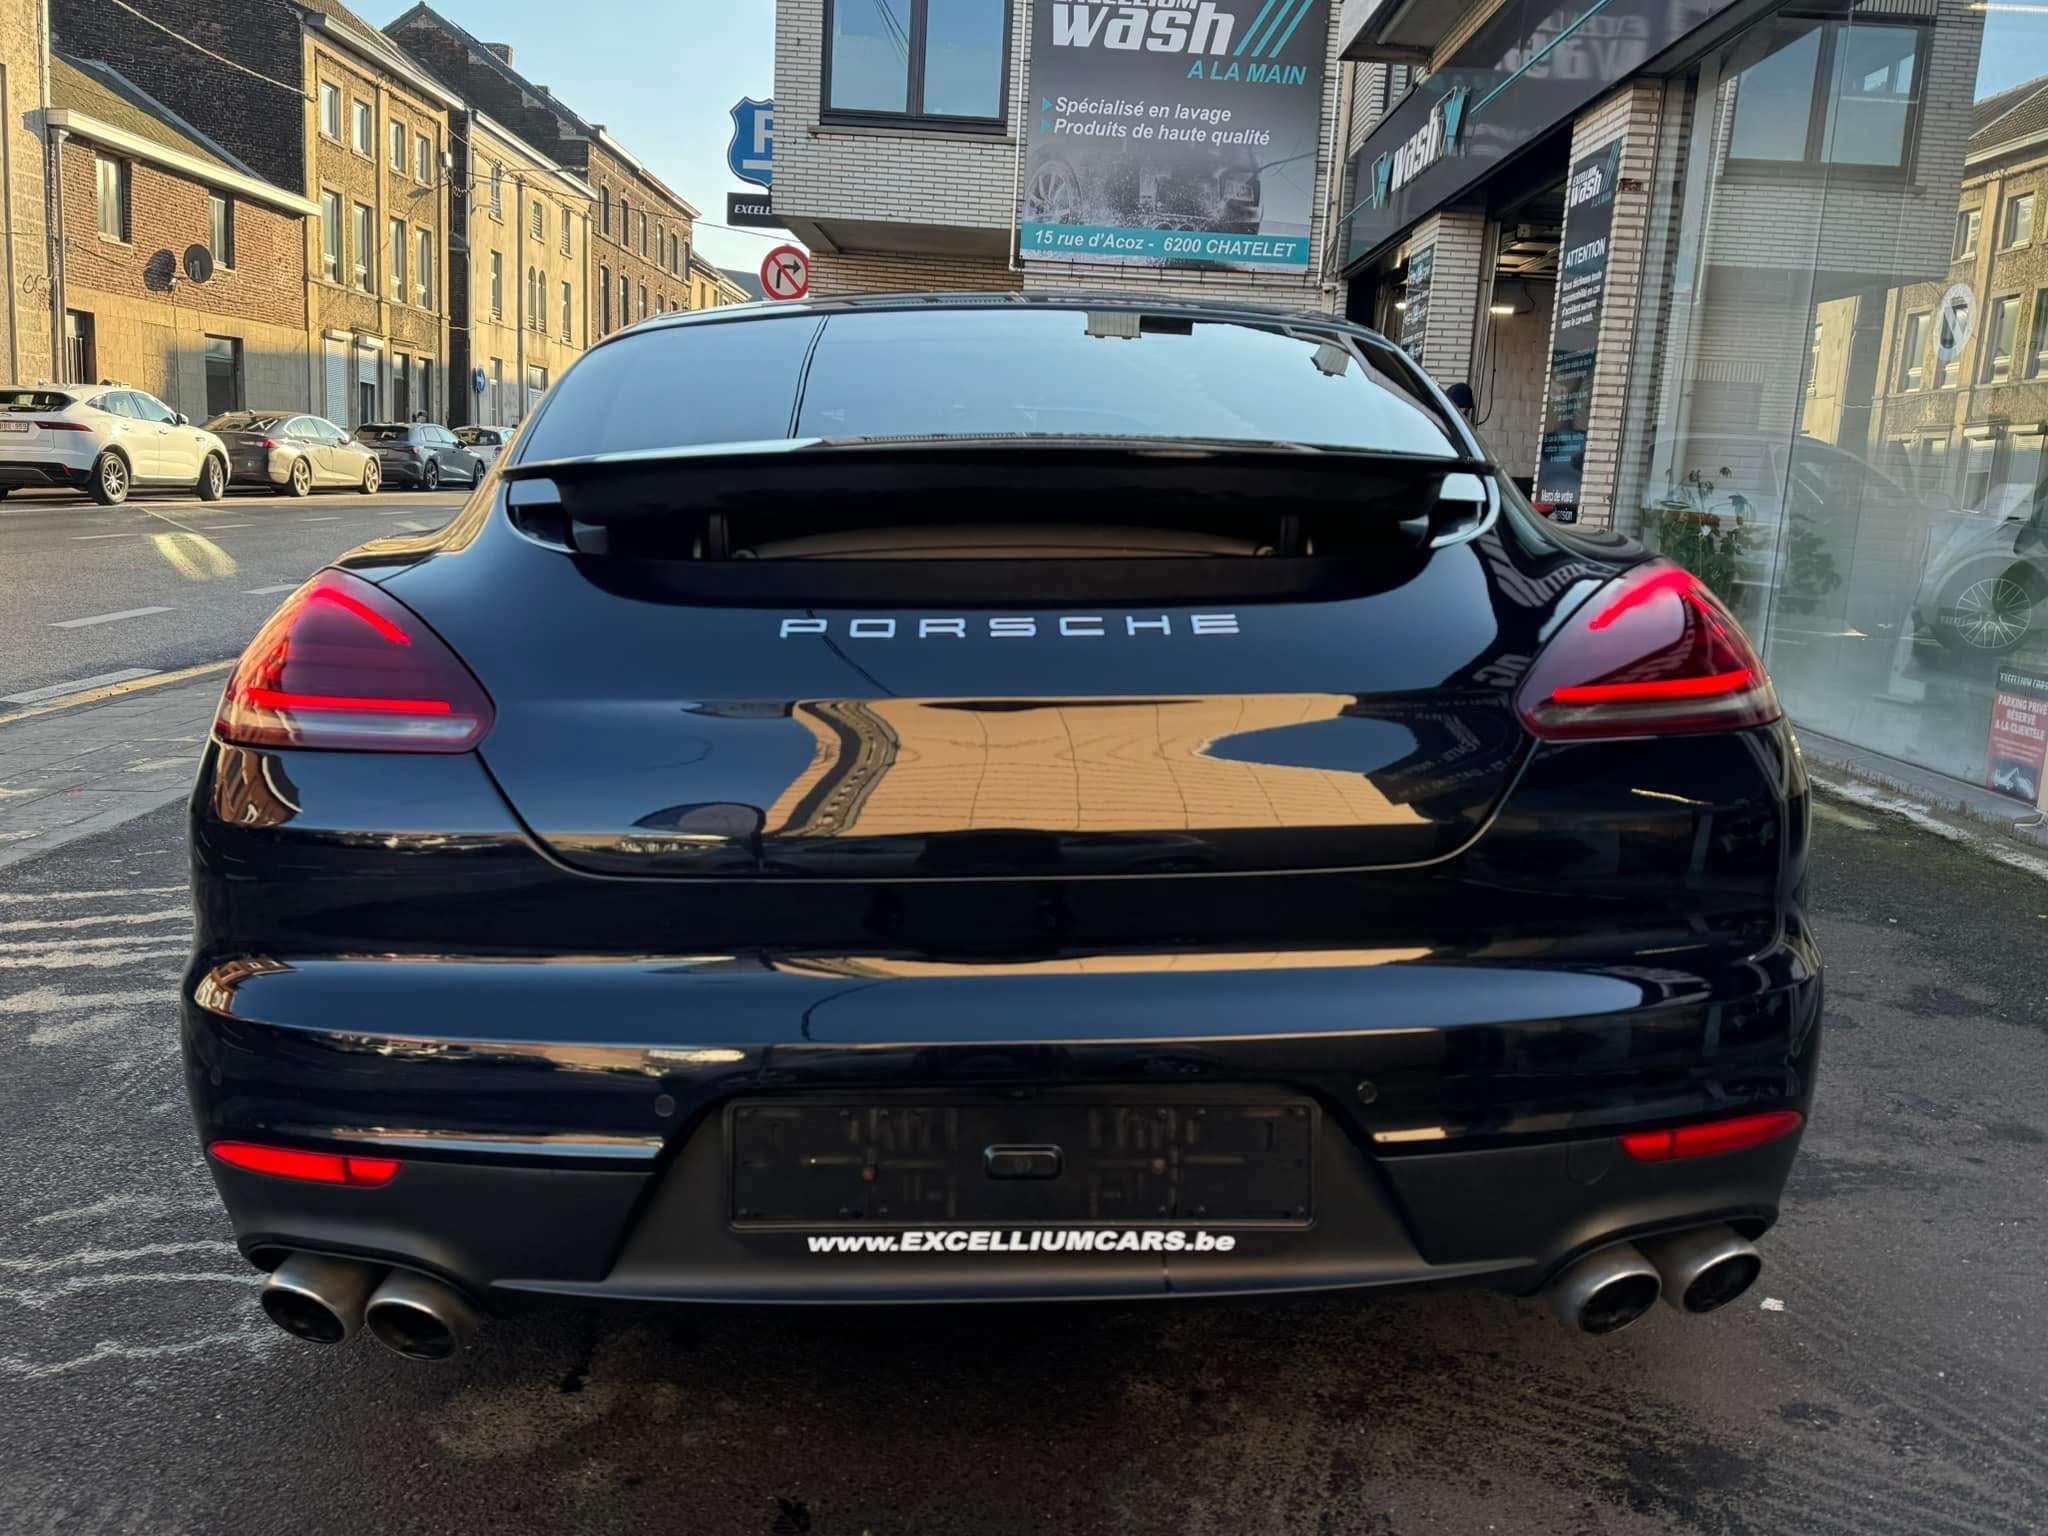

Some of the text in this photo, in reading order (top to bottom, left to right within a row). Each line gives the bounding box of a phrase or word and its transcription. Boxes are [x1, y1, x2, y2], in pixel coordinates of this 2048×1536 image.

[1052, 2, 1235, 55] wash
[1210, 61, 1241, 81] LA
[1246, 63, 1306, 85] MAIN
[1055, 97, 1232, 125] Spécialisé en lavage
[1054, 119, 1270, 148] Produits de haute qualité
[1391, 106, 1442, 193] wash
[1570, 170, 1603, 208] wash
[734, 204, 773, 215] EXCELL
[1035, 230, 1053, 245] 15
[1057, 234, 1083, 247] rue
[1088, 232, 1145, 250] d'Acoz
[1163, 238, 1201, 252] 6200
[1207, 239, 1297, 257] CHATELET
[1565, 237, 1607, 269] ATTENTION
[779, 613, 1240, 639] PORSCHE
[807, 1230, 1236, 1252] www.EXCELLIUMCARS.be
